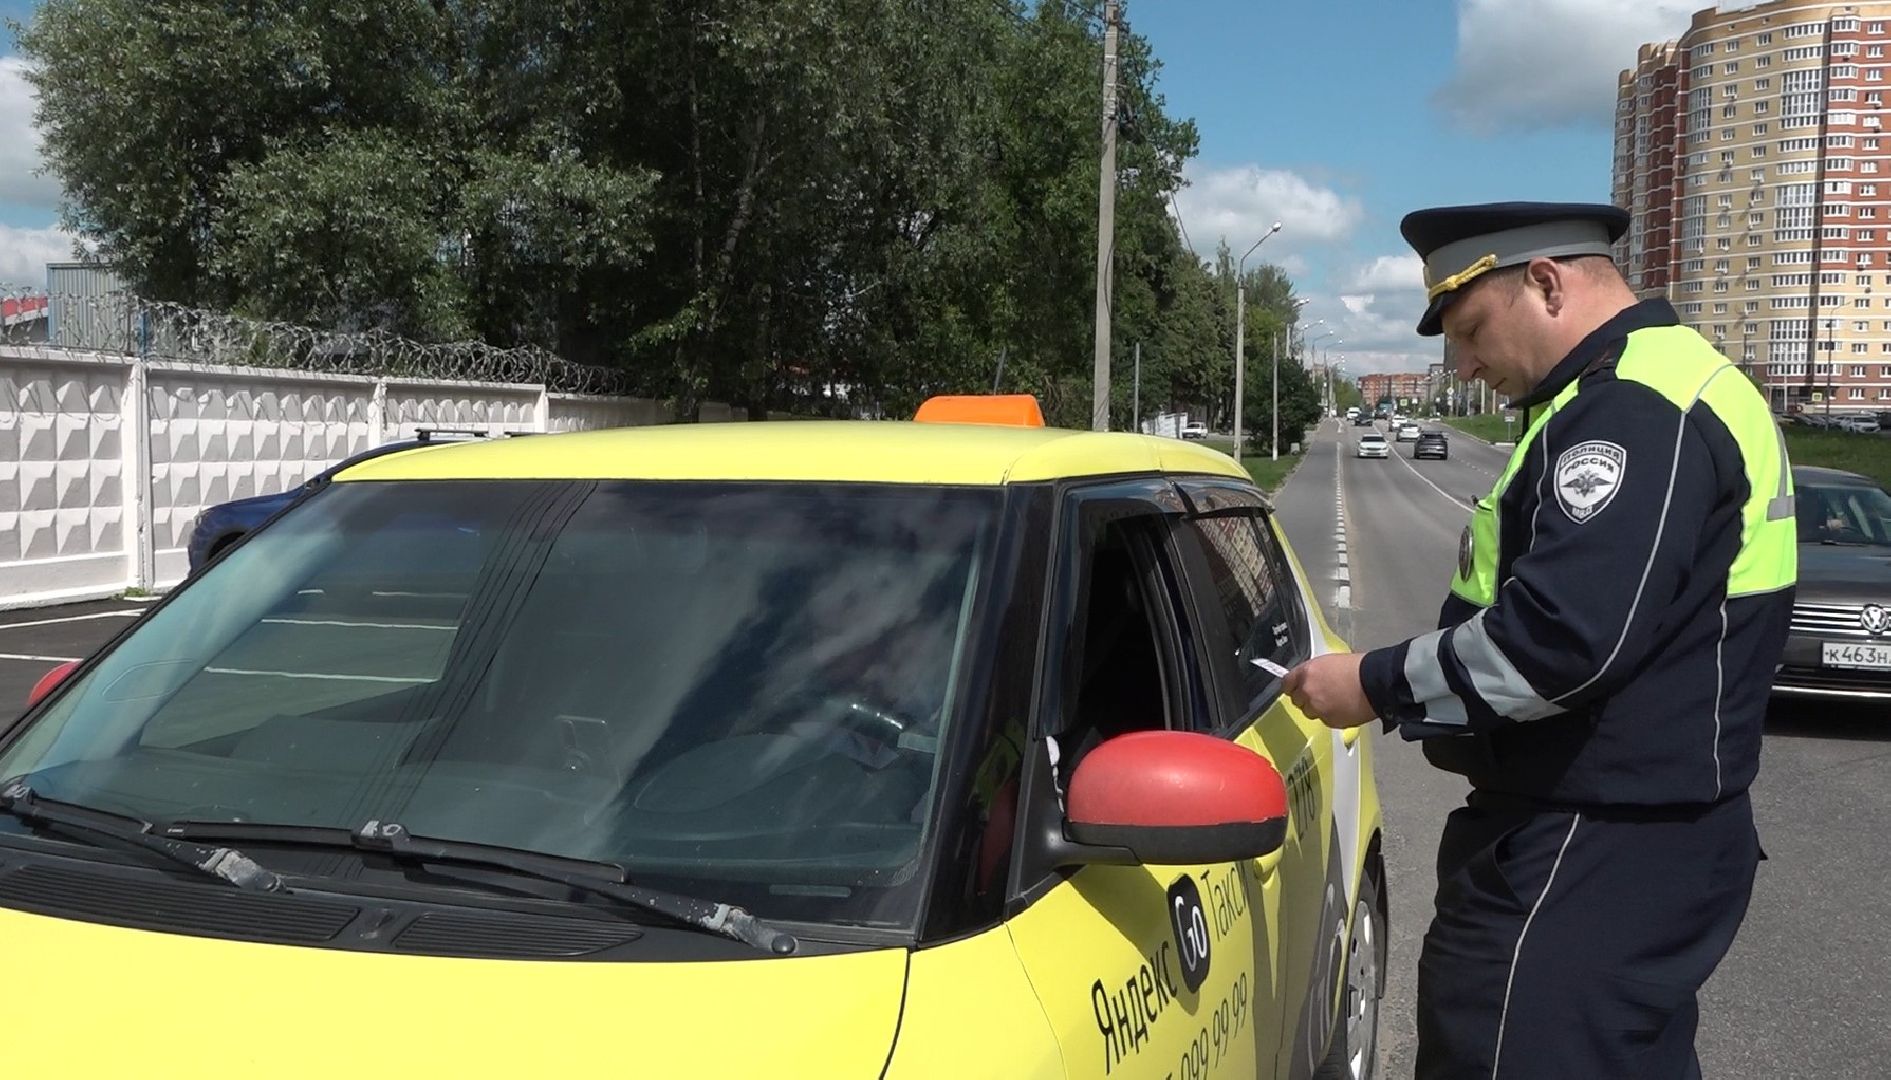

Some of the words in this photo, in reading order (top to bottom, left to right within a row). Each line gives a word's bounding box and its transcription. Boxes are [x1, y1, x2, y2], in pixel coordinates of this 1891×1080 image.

[1563, 446, 1620, 462] ПОЛИЦИЯ
[1829, 646, 1891, 664] К463Н
[1091, 941, 1177, 1075] Яндекс
[1213, 997, 1228, 1070] 99
[1232, 972, 1247, 1040] 99
